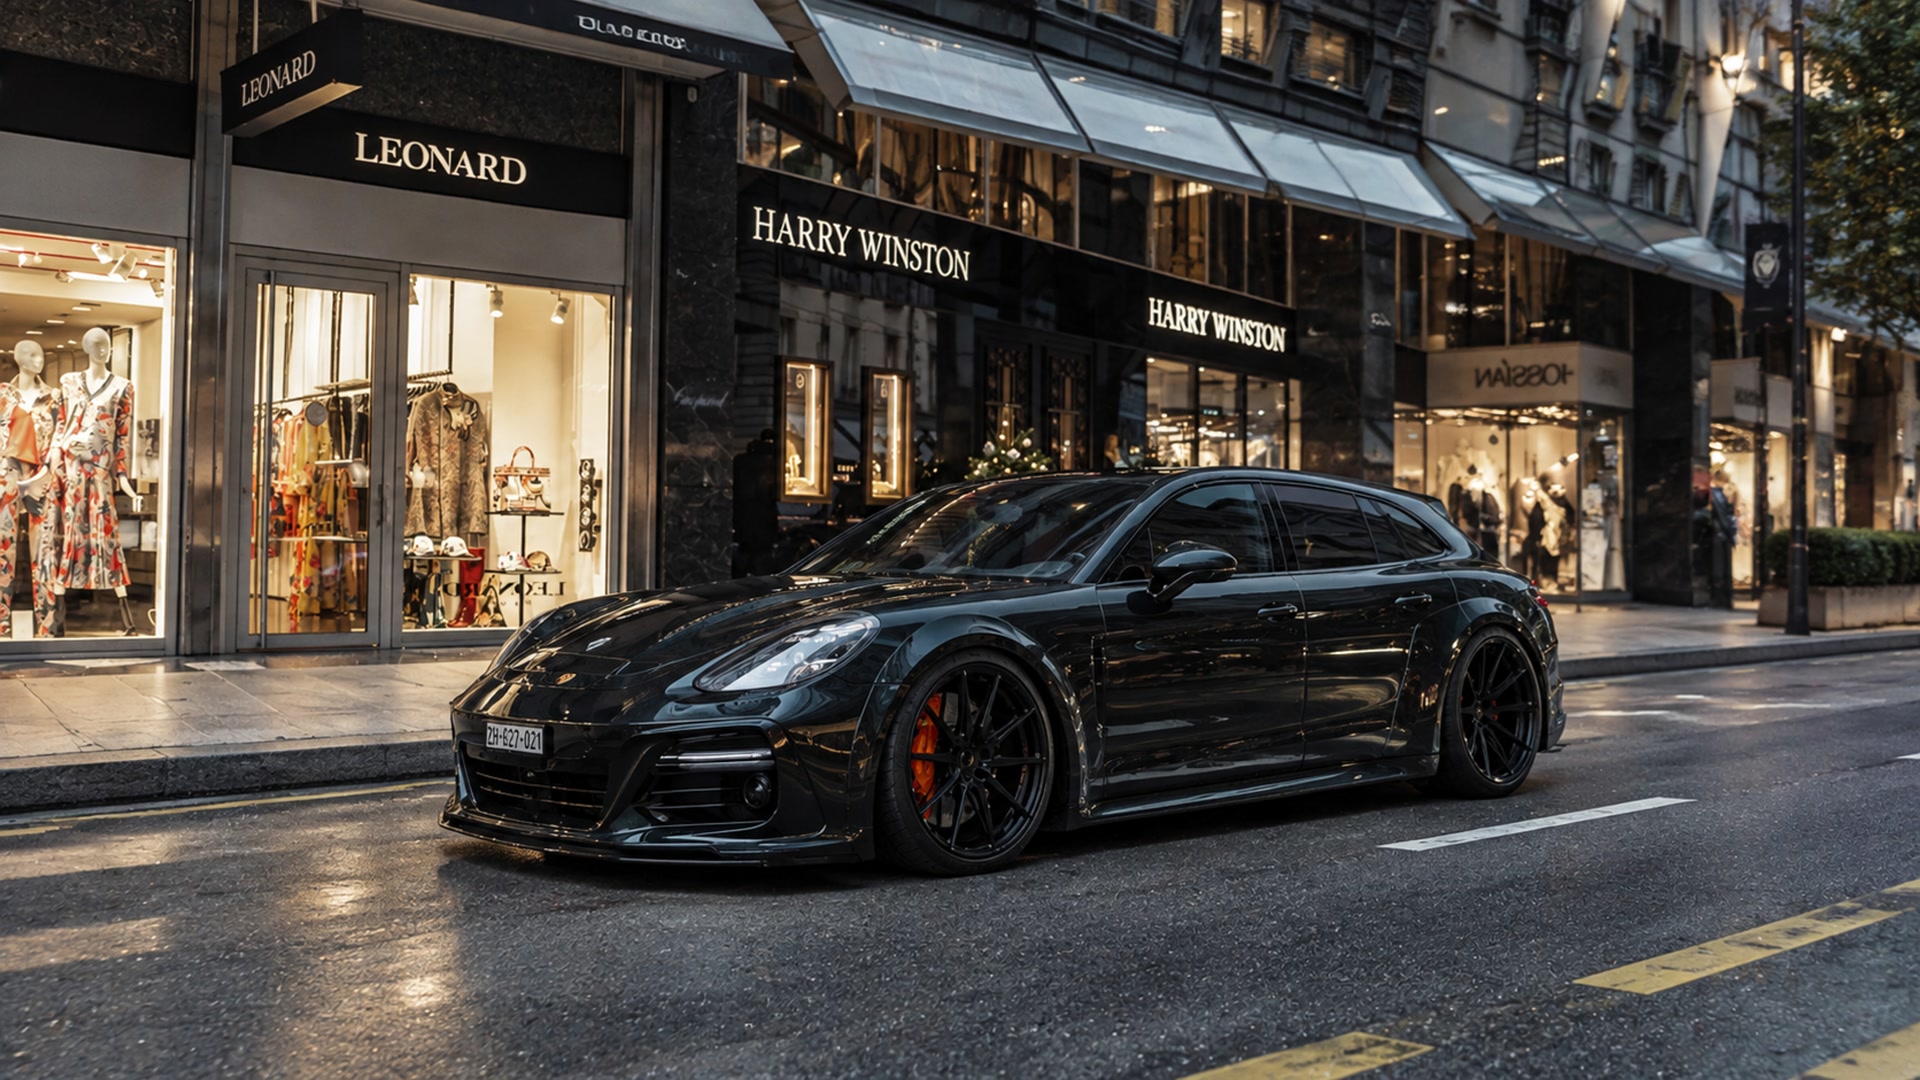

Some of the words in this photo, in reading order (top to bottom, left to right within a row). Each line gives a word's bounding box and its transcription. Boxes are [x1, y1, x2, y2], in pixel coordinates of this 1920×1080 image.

[241, 50, 316, 107] LEONARD
[355, 132, 527, 185] LEONARD
[753, 206, 852, 257] HARRY
[858, 228, 970, 281] WINSTON
[1148, 297, 1210, 336] HARRY
[1212, 312, 1286, 352] WINSTON
